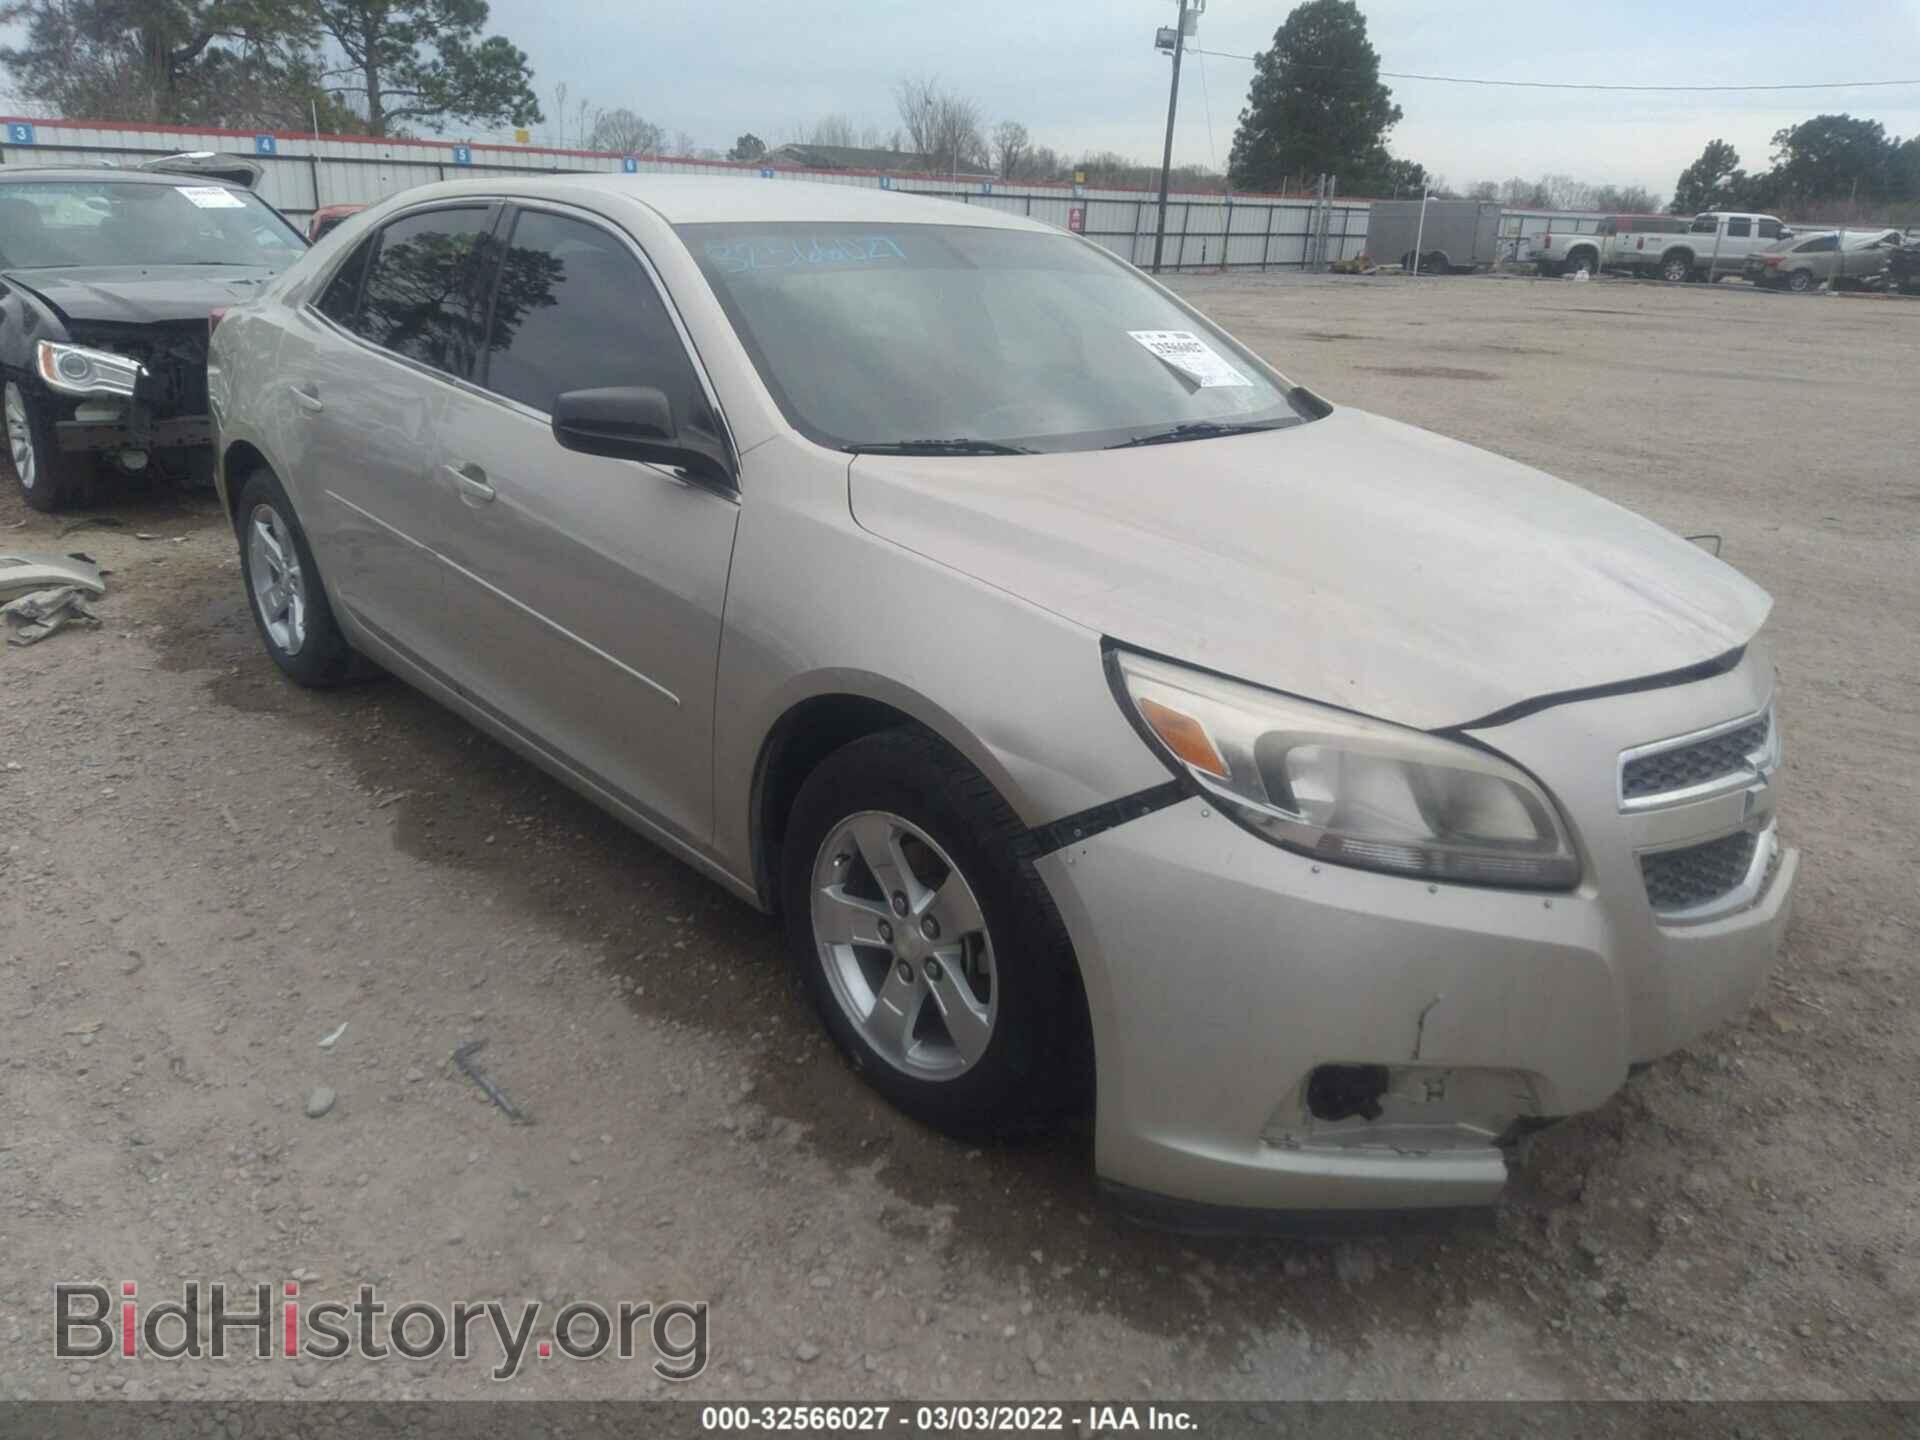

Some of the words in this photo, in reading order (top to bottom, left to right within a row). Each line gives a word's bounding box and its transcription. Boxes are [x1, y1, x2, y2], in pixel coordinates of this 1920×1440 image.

[16, 126, 26, 141] 3
[262, 137, 270, 152] 4
[458, 149, 467, 161] 5
